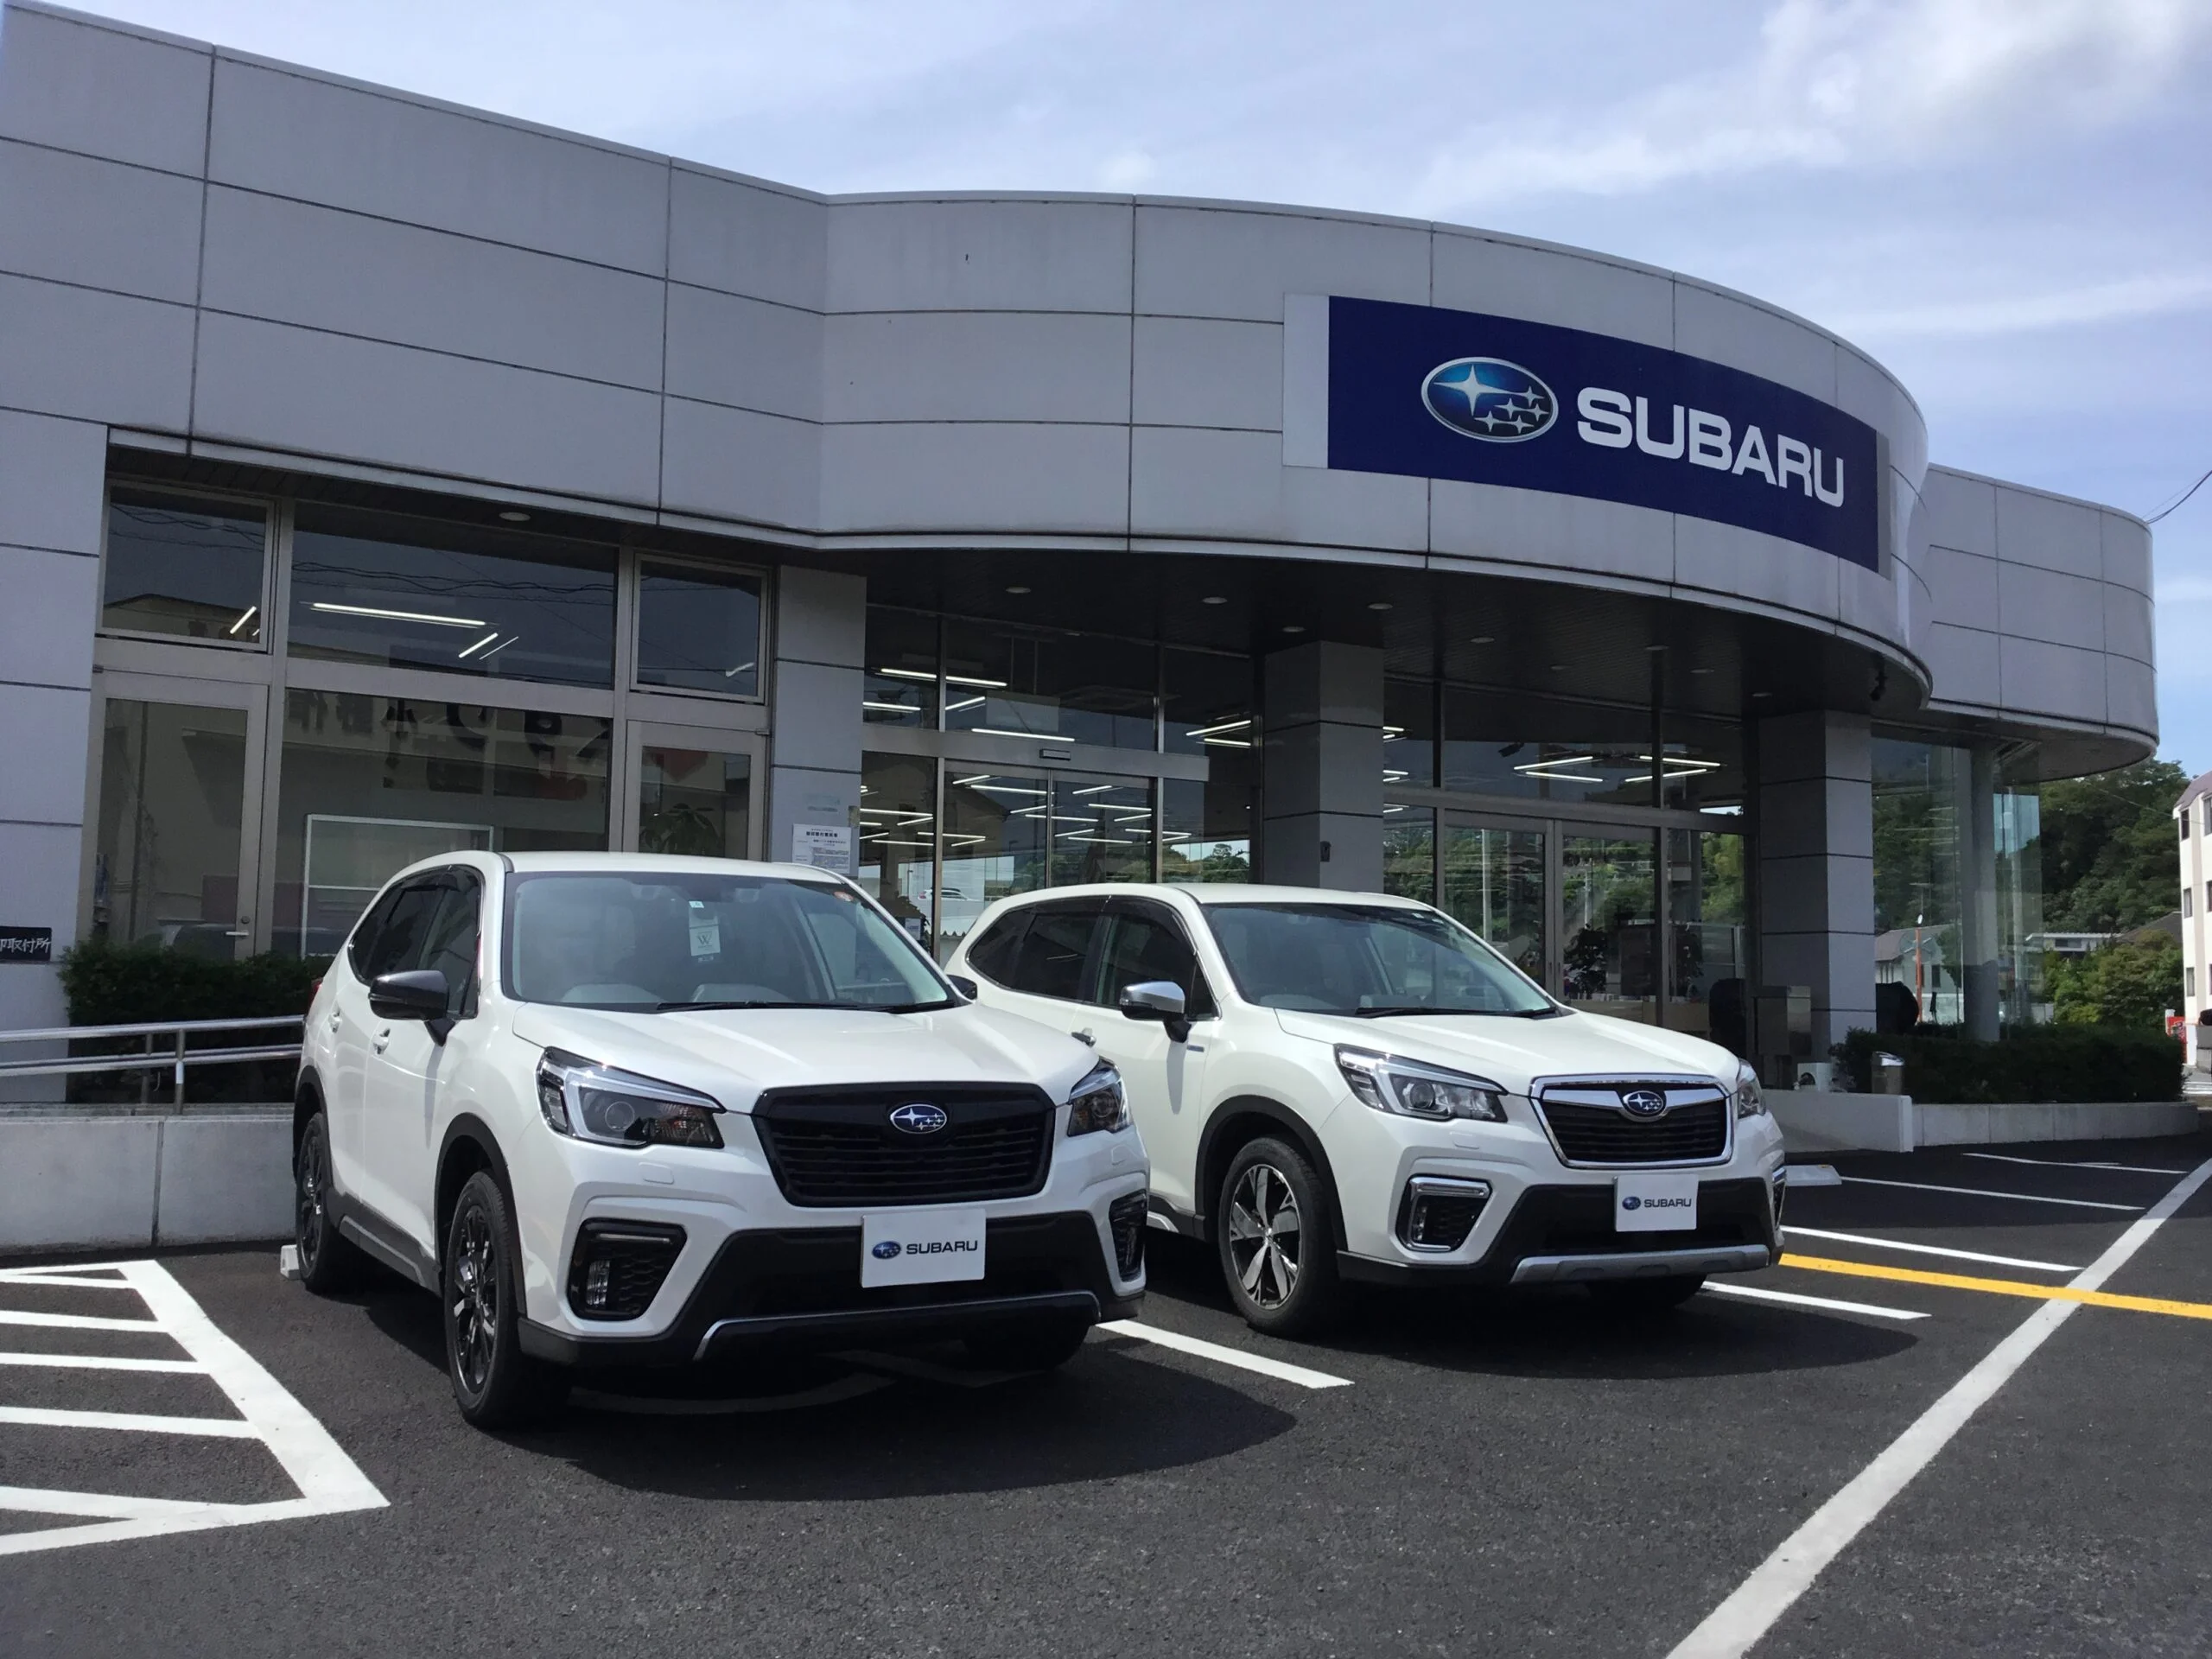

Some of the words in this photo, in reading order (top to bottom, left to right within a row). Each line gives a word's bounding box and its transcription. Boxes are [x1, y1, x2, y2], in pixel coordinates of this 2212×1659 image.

[1577, 386, 1844, 507] SUBARU
[1644, 1198, 1692, 1208] SUBARU
[906, 1240, 978, 1255] SUBARU
